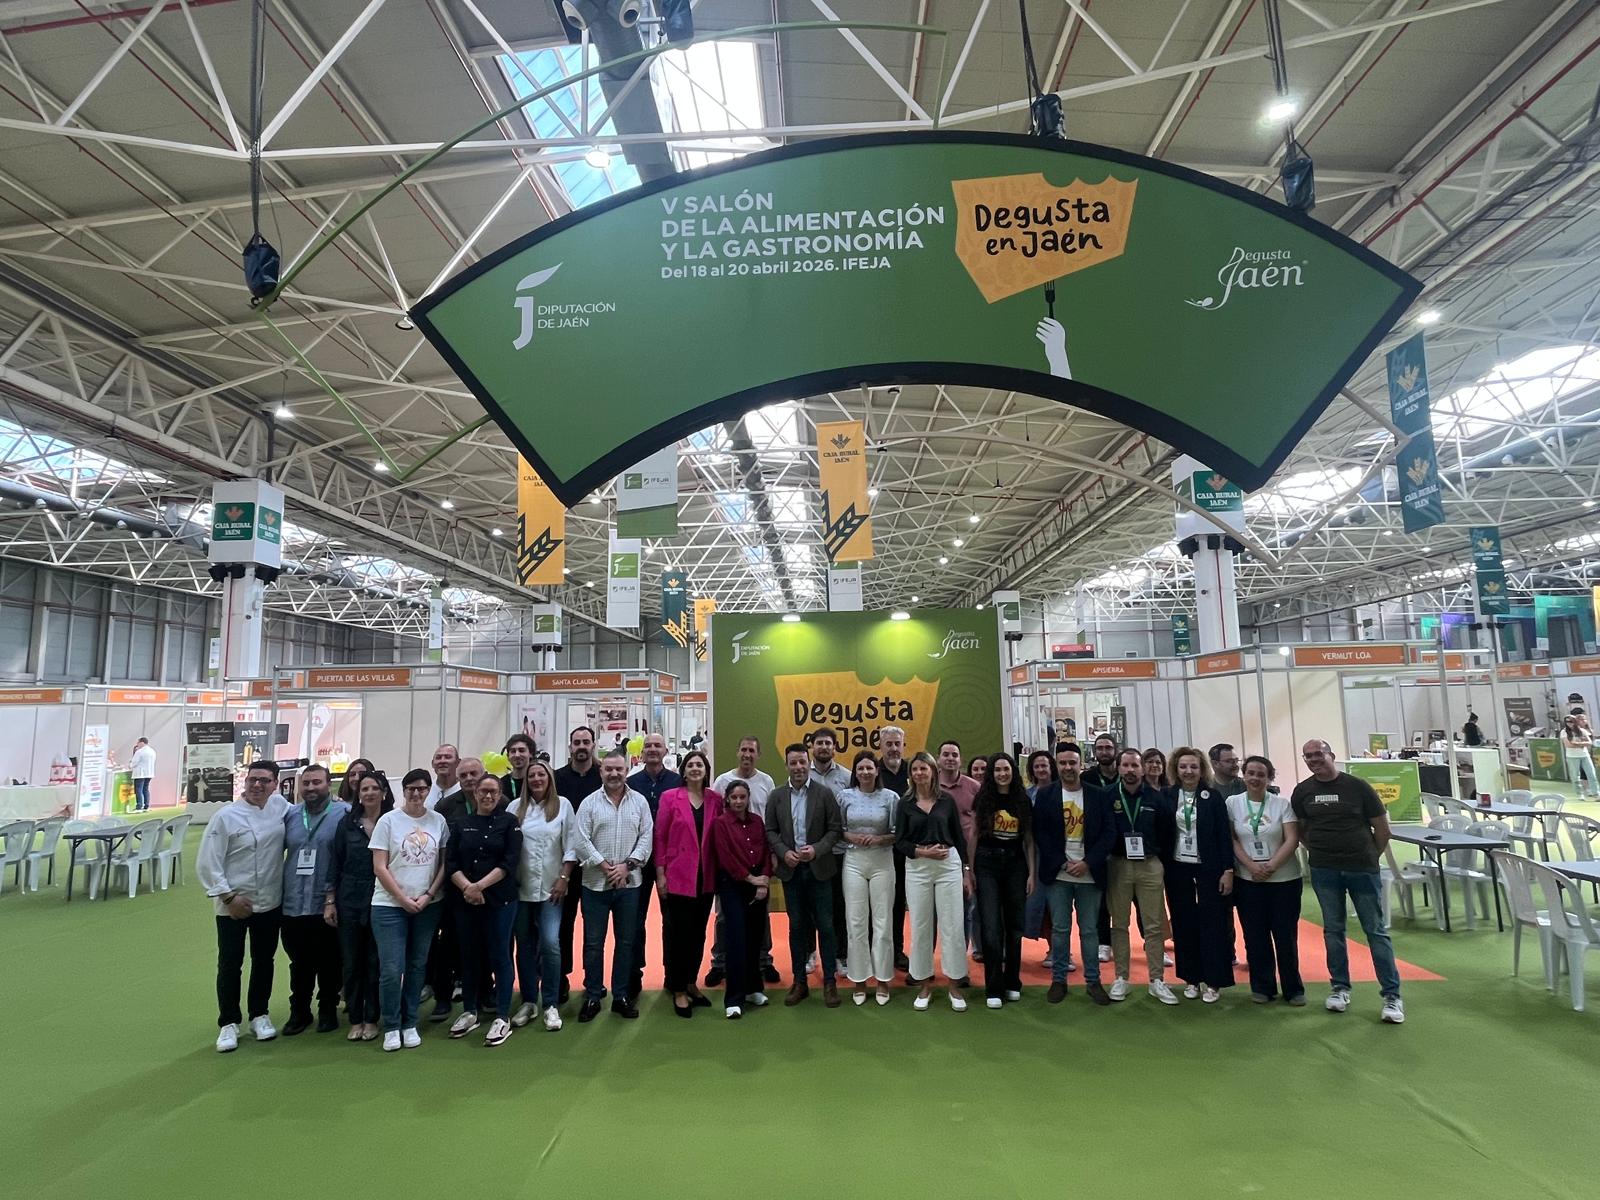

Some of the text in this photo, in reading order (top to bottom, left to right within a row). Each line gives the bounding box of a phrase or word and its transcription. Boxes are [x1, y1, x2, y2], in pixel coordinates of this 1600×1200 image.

[661, 188, 773, 215] V SALÓN
[974, 198, 1111, 232] Degusta
[662, 202, 945, 238] DE LA ALIMENTACIÓN
[661, 227, 924, 261] Y LA GASTRONOMÍA
[986, 228, 1103, 258] en Jaén
[661, 256, 892, 279] Del 18 al 20 abril 2026. IFEJA
[537, 302, 616, 315] DIPUTACIÓN
[537, 316, 589, 329] DE JAÉN
[1215, 491, 1240, 499] RURAL
[1321, 650, 1372, 660] VERMUT LOA
[316, 673, 395, 682] PUERTA DE LAS VILLAS
[793, 696, 915, 726] Degusta
[835, 726, 882, 753] Jaé
